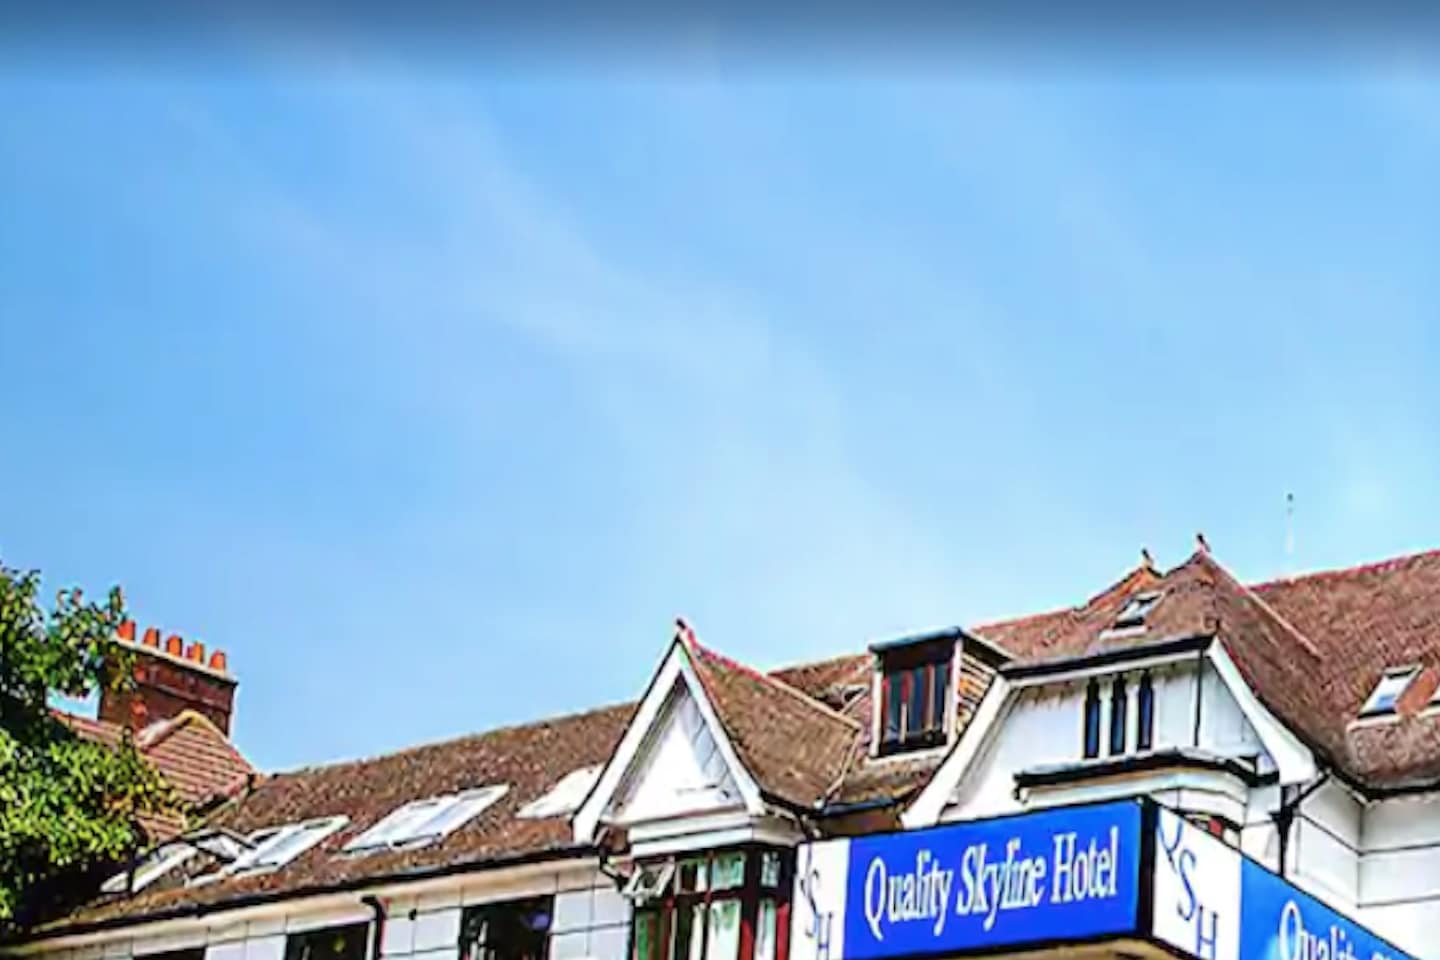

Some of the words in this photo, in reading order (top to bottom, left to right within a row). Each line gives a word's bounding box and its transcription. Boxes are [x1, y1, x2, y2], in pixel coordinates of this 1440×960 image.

[864, 848, 953, 941] Quality
[957, 836, 1045, 932] Skyline
[1050, 826, 1118, 903] Hotel
